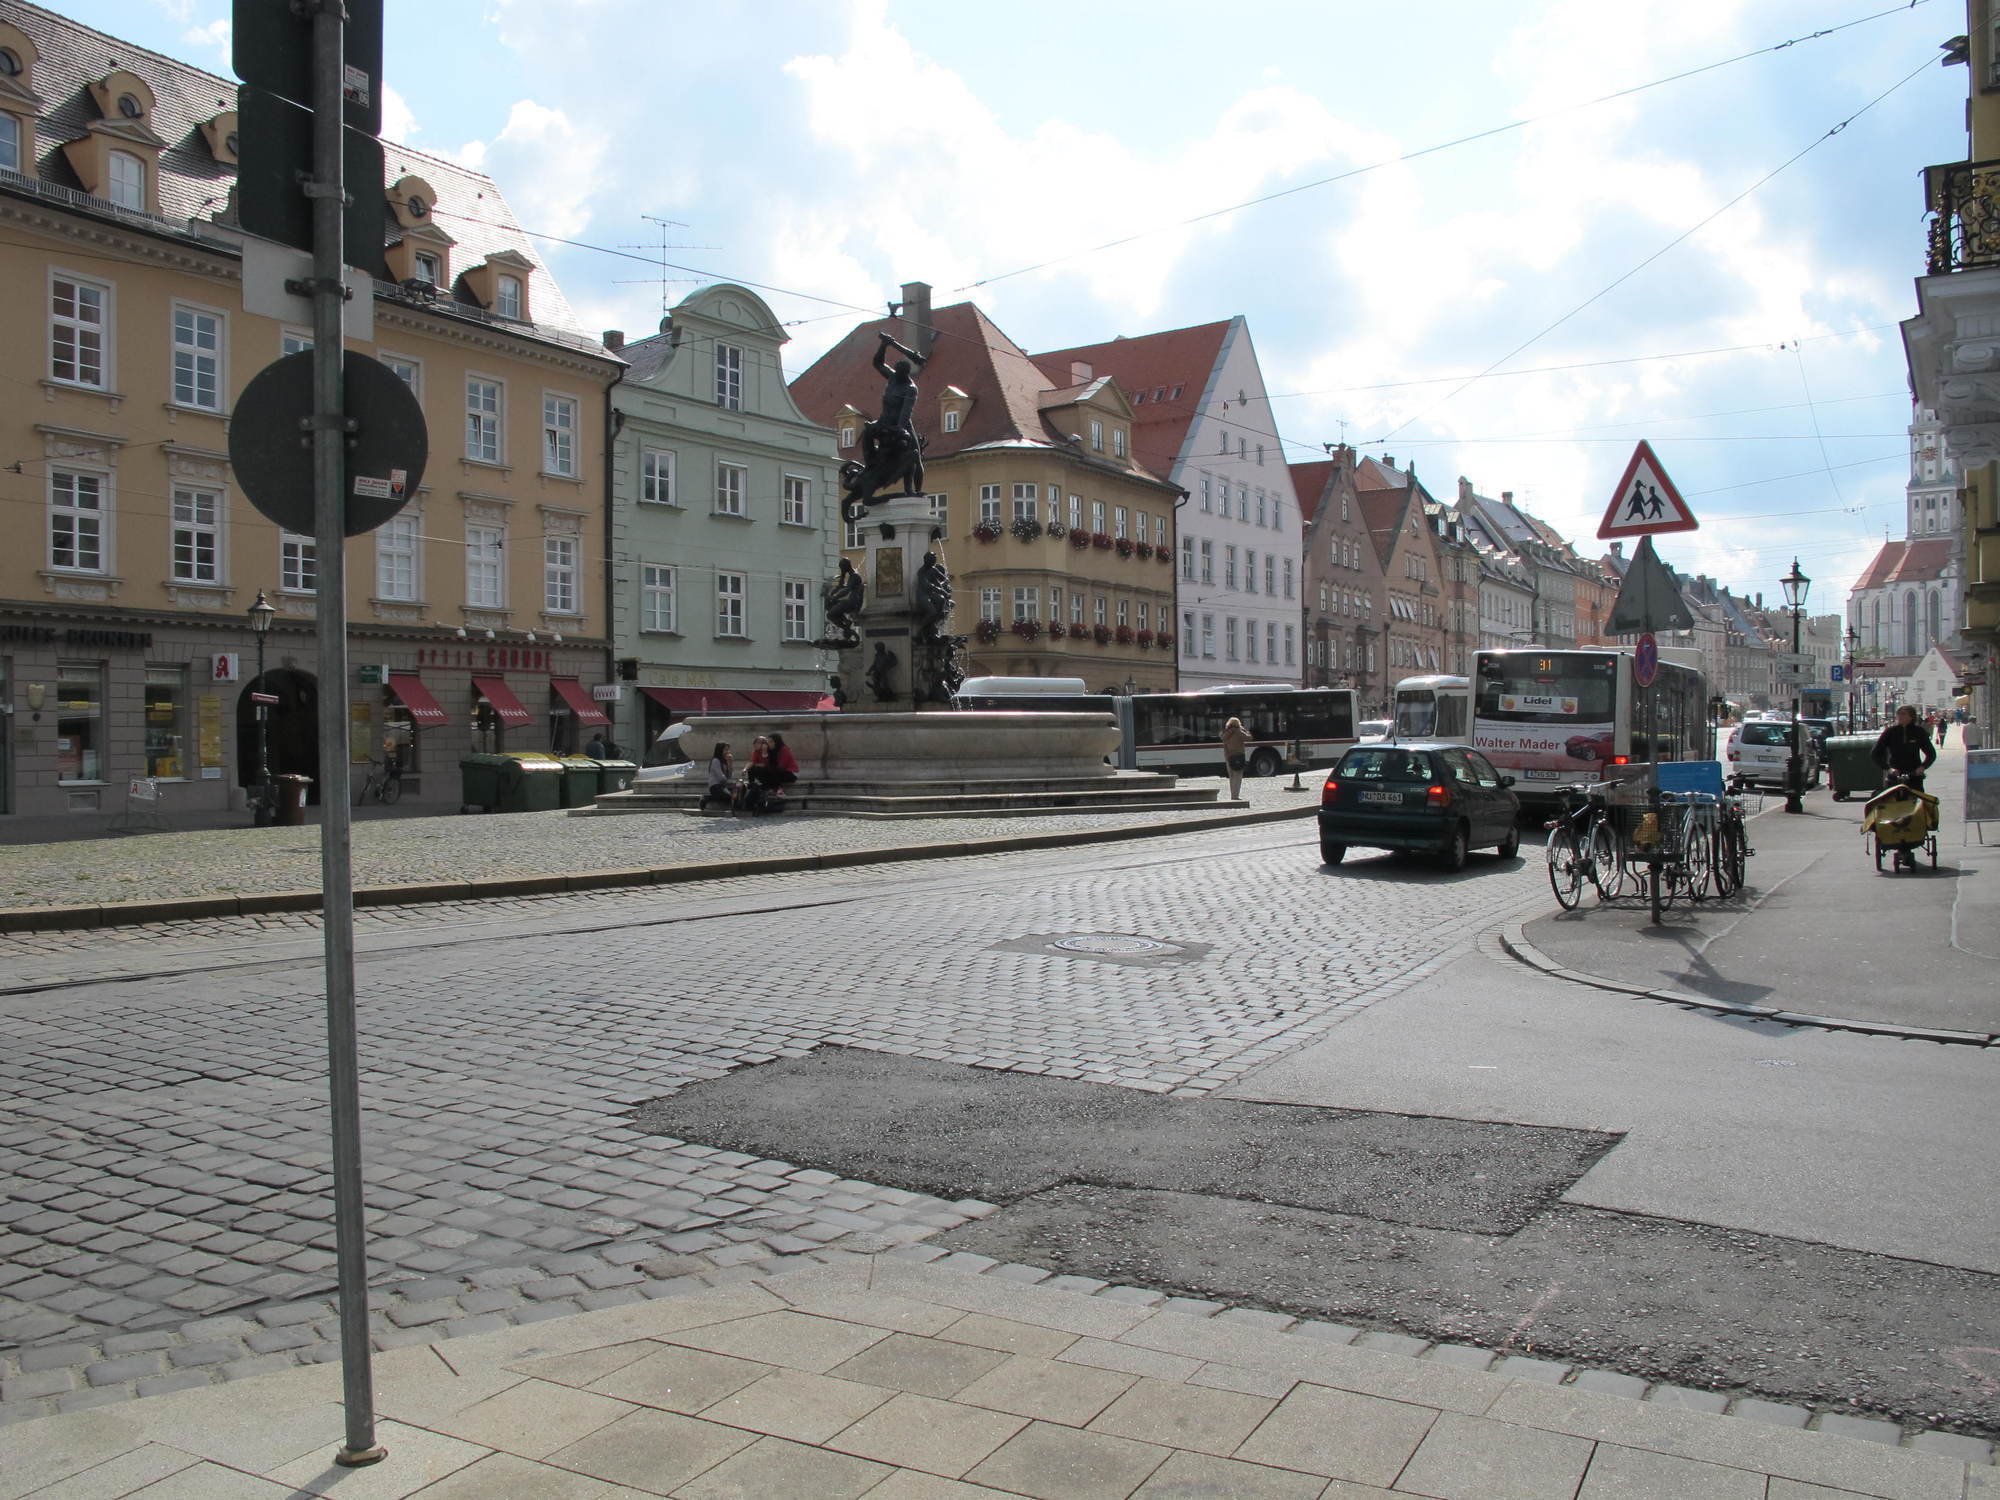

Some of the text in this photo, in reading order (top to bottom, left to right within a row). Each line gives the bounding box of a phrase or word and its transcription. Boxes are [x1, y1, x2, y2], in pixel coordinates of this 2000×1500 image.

[215, 655, 229, 678] A
[1539, 658, 1552, 671] 31
[1833, 667, 1842, 680] P
[1523, 696, 1552, 705] Lidel
[1475, 736, 1561, 751] Walter Mader
